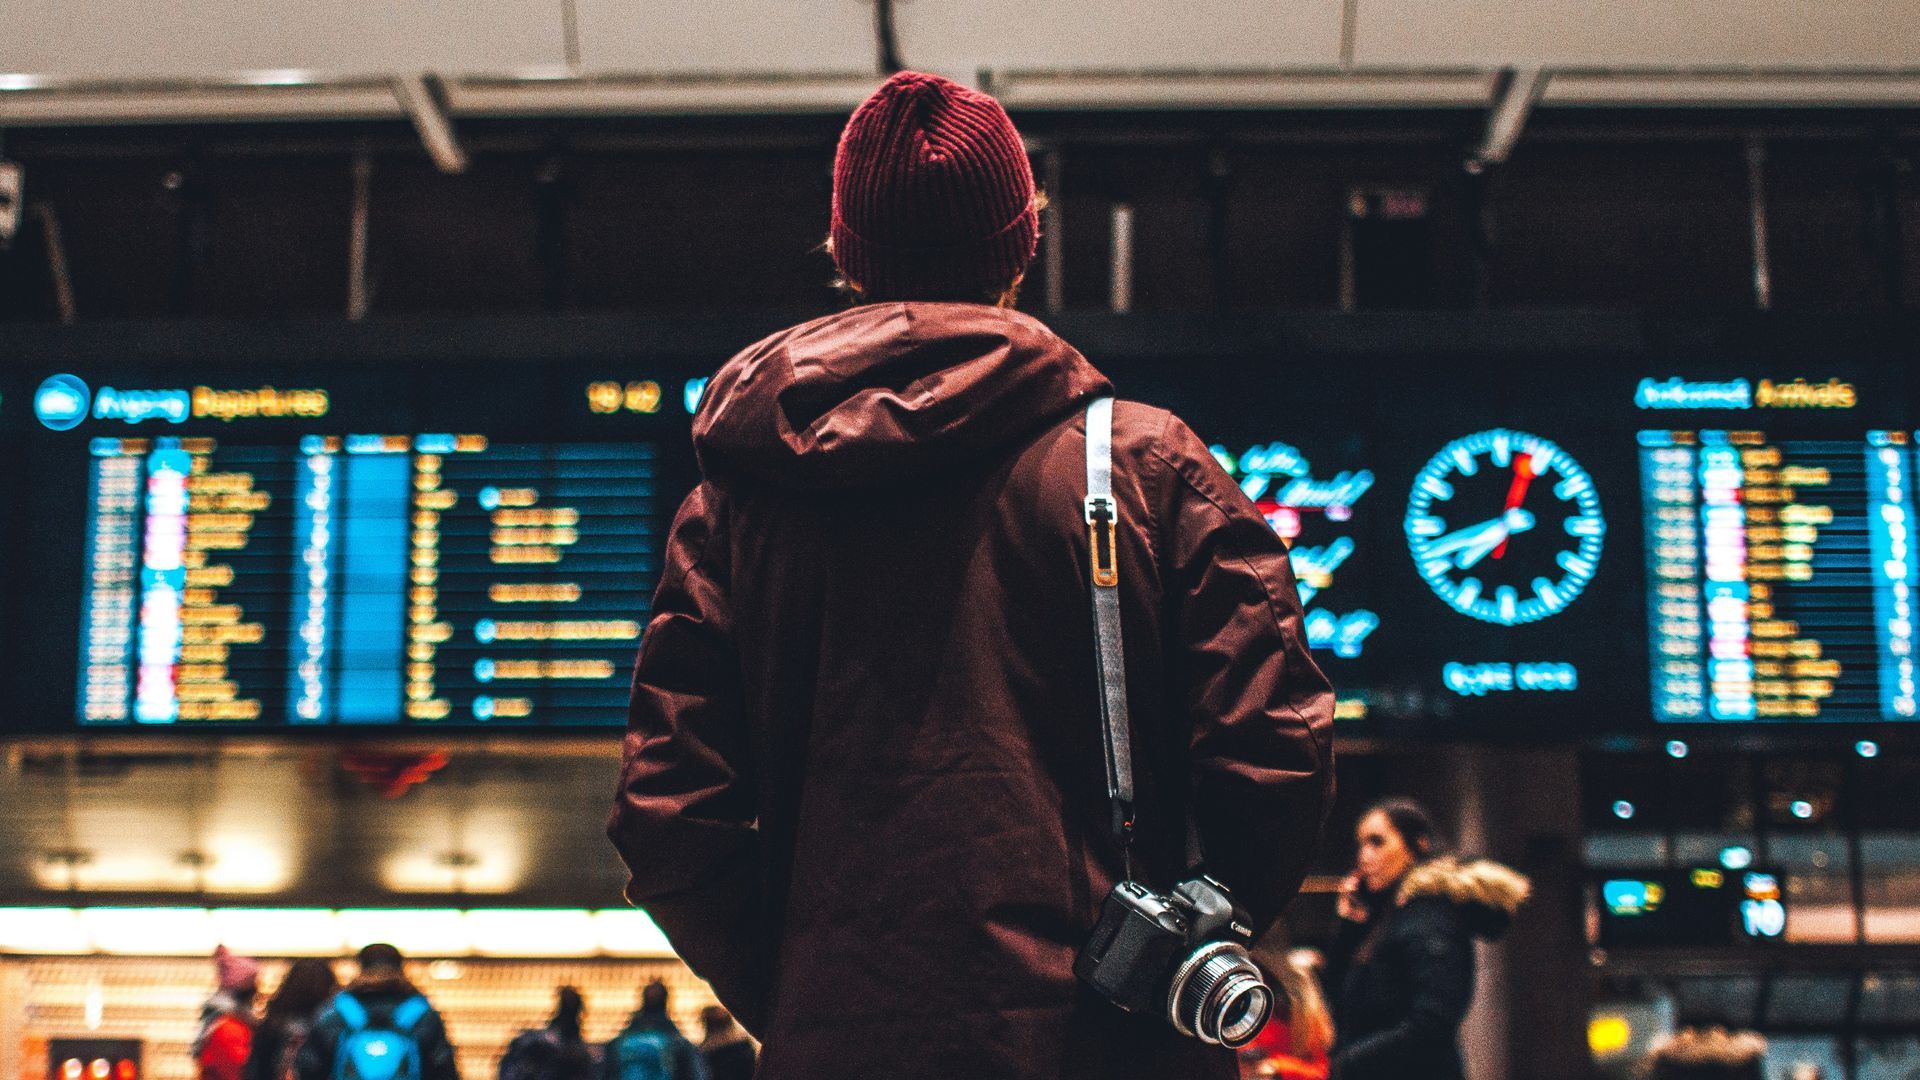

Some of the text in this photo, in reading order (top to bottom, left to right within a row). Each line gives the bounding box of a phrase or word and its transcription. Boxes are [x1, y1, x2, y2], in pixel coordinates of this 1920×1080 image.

[192, 385, 328, 421] Departures
[1756, 378, 1857, 408] Arrivals
[1230, 921, 1252, 937] Canon
